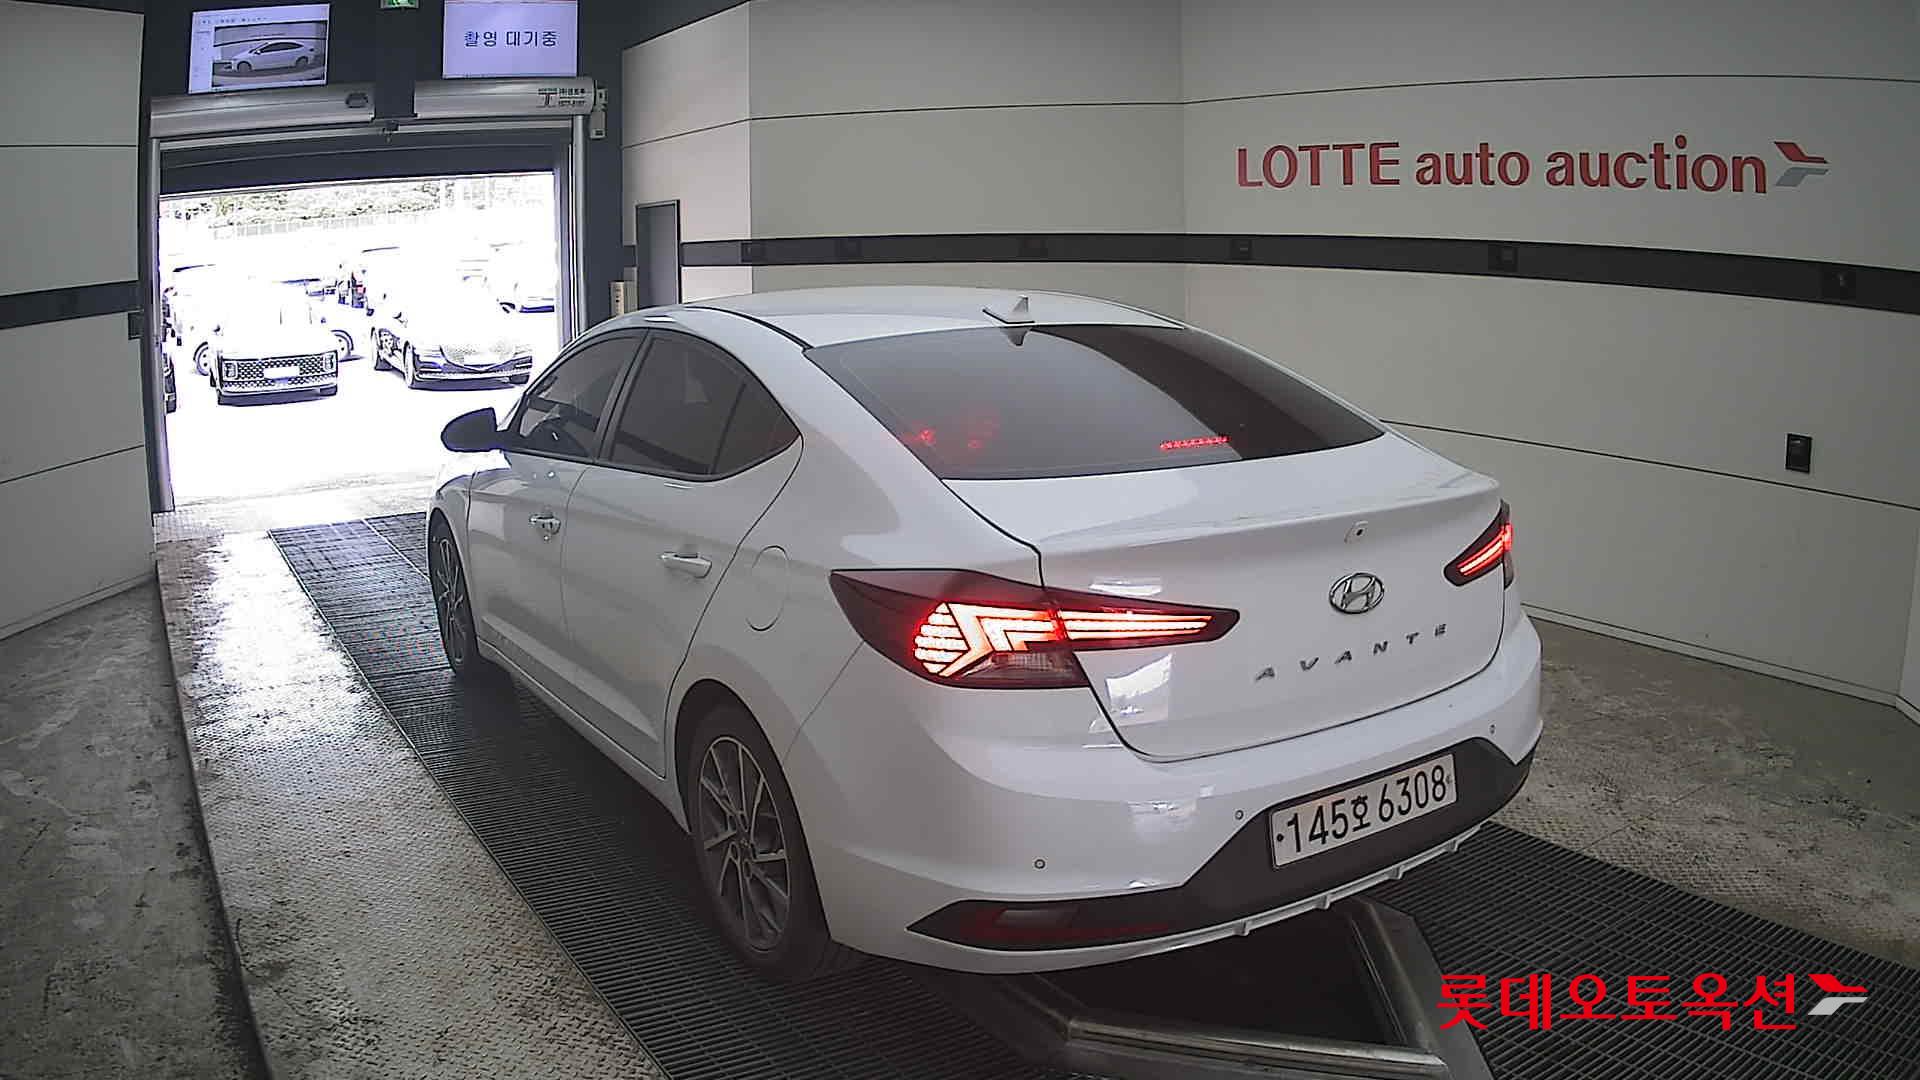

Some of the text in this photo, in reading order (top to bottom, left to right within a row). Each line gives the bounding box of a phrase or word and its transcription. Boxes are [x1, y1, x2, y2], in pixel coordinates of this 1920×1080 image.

[506, 31, 557, 47] 대기중
[1236, 134, 1767, 194] LOTTE auto auction
[1255, 623, 1447, 682] AVANTE
[1287, 765, 1447, 853] 145호 6308
